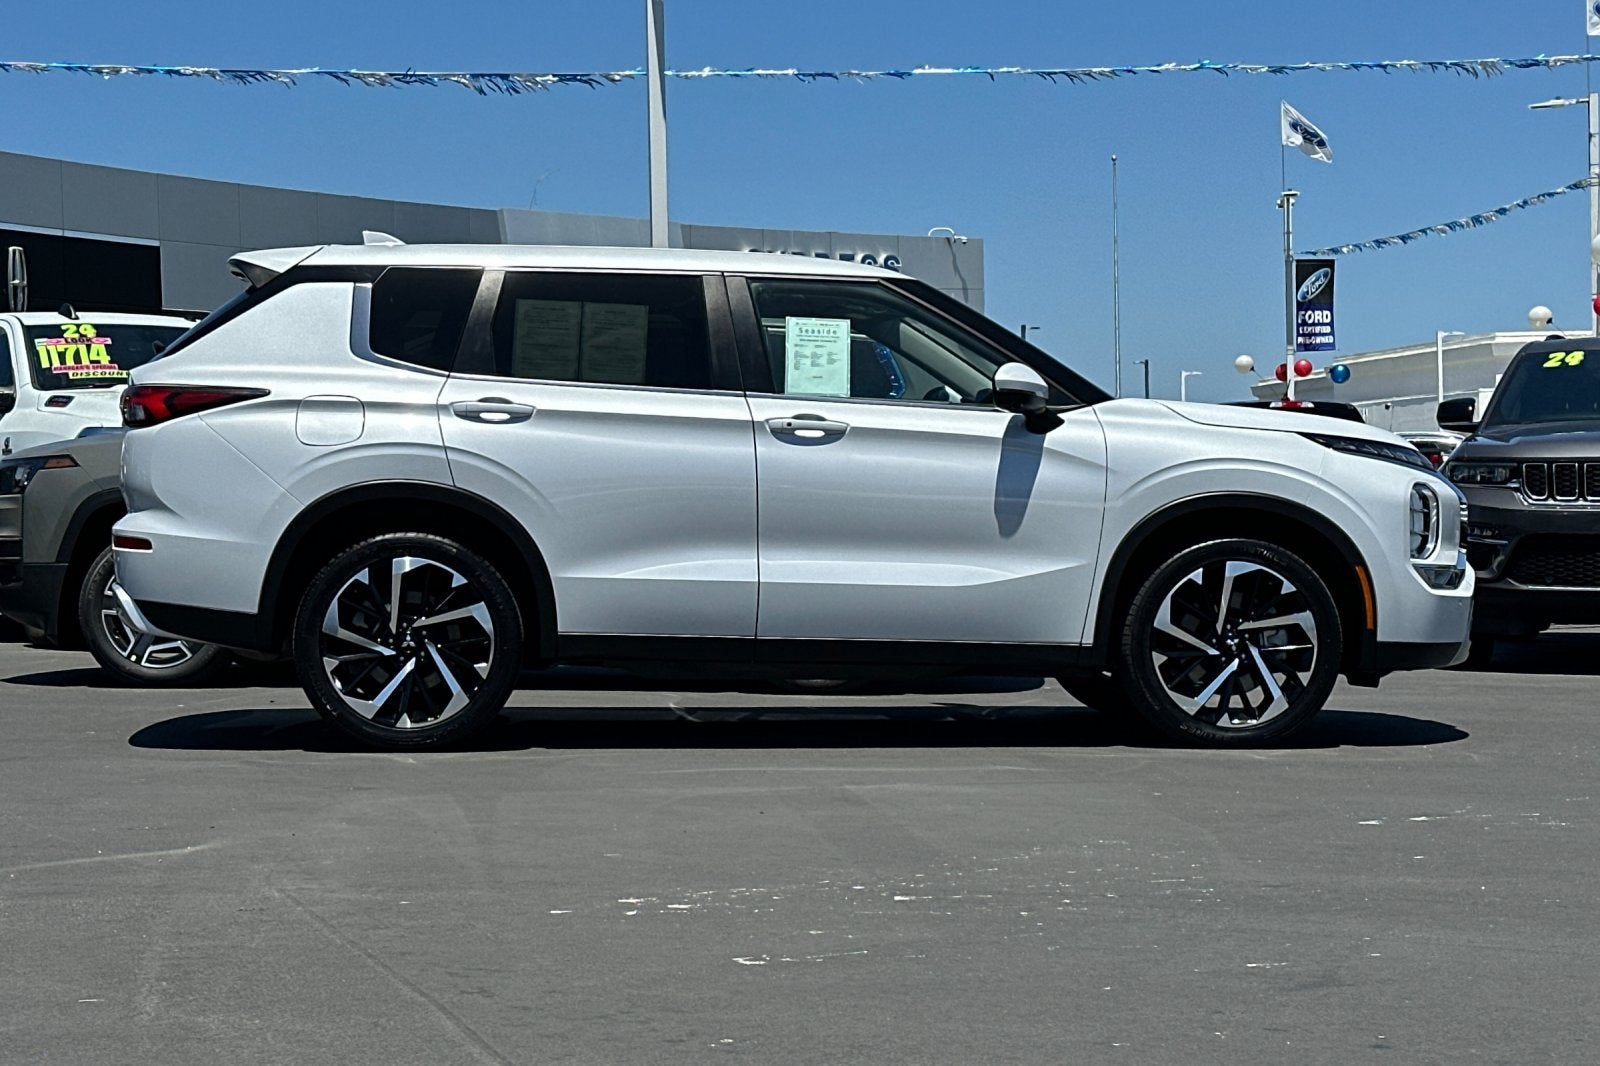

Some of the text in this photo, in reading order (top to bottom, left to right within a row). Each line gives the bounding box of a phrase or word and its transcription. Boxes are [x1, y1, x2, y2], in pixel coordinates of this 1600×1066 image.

[1304, 273, 1326, 298] Ford
[1298, 310, 1331, 324] FORD
[36, 343, 111, 369] 11714
[1542, 350, 1585, 368] 24
